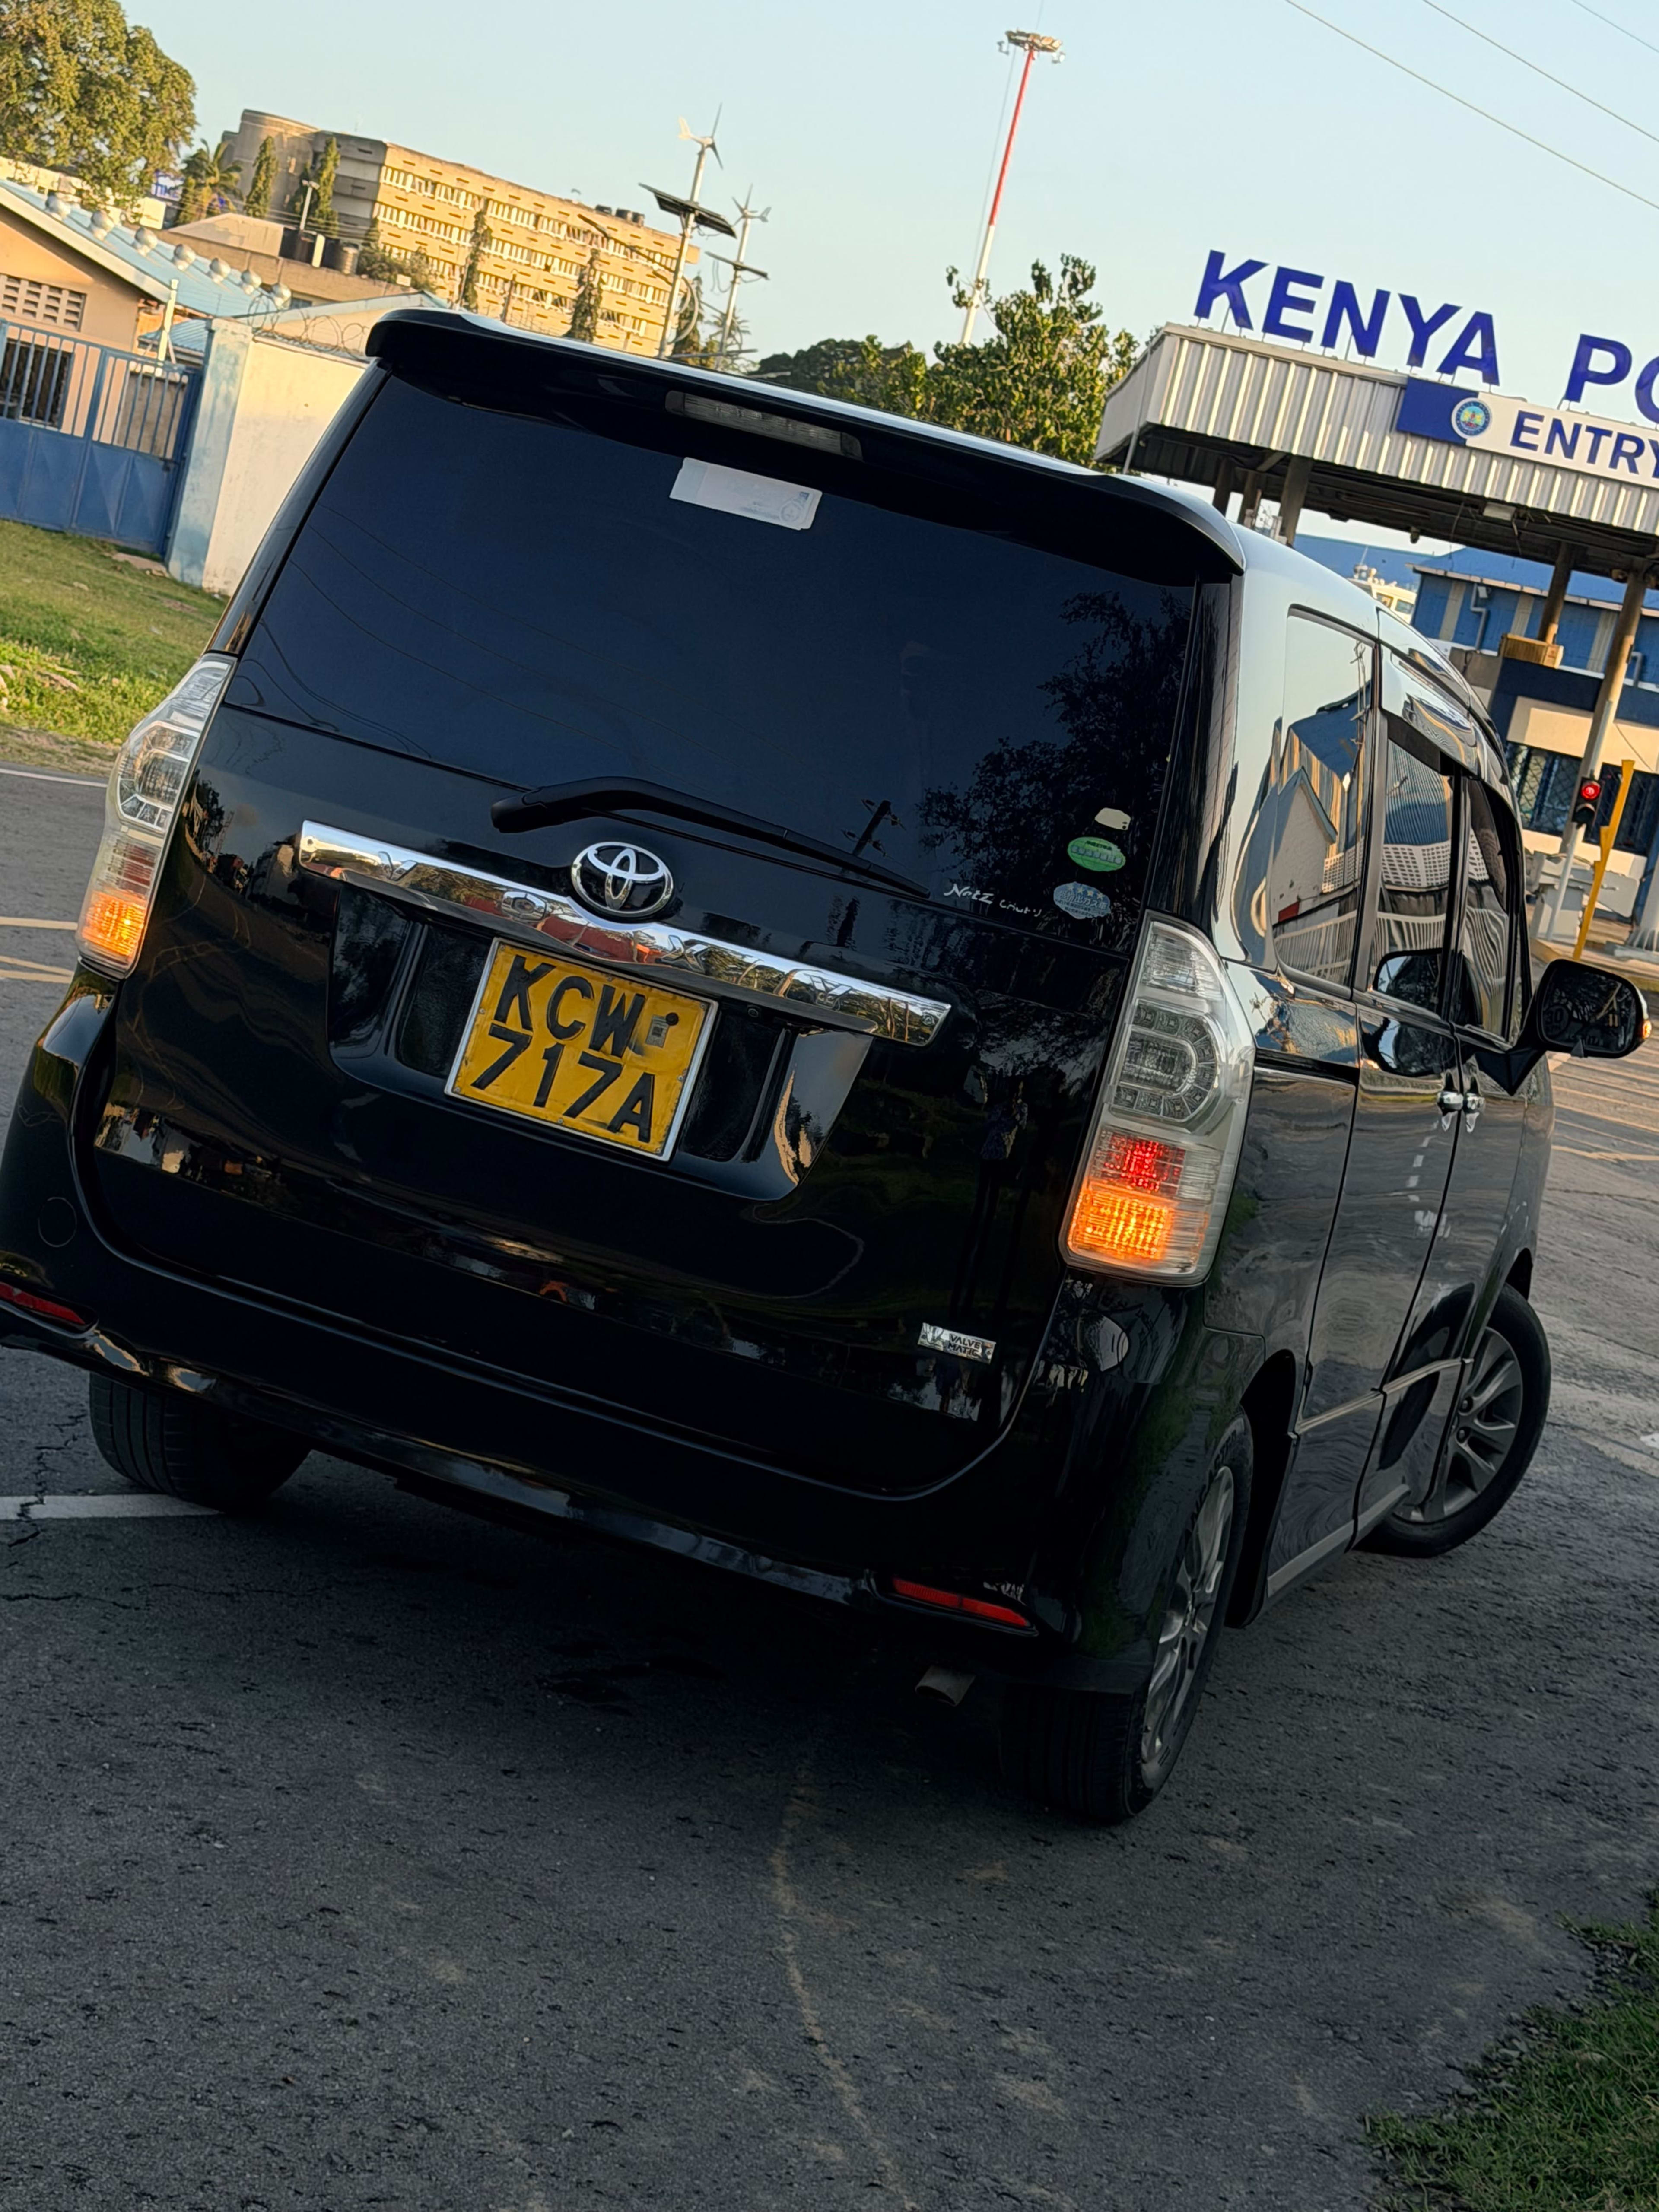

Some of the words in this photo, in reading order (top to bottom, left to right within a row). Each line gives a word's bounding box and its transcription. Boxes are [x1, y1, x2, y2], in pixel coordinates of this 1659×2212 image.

[1194, 249, 1500, 387] KENYA
[493, 954, 647, 1058] KCW
[470, 1023, 655, 1143] 717A
[947, 1343, 979, 1356] MATIC
[950, 1334, 980, 1348] VALVE
